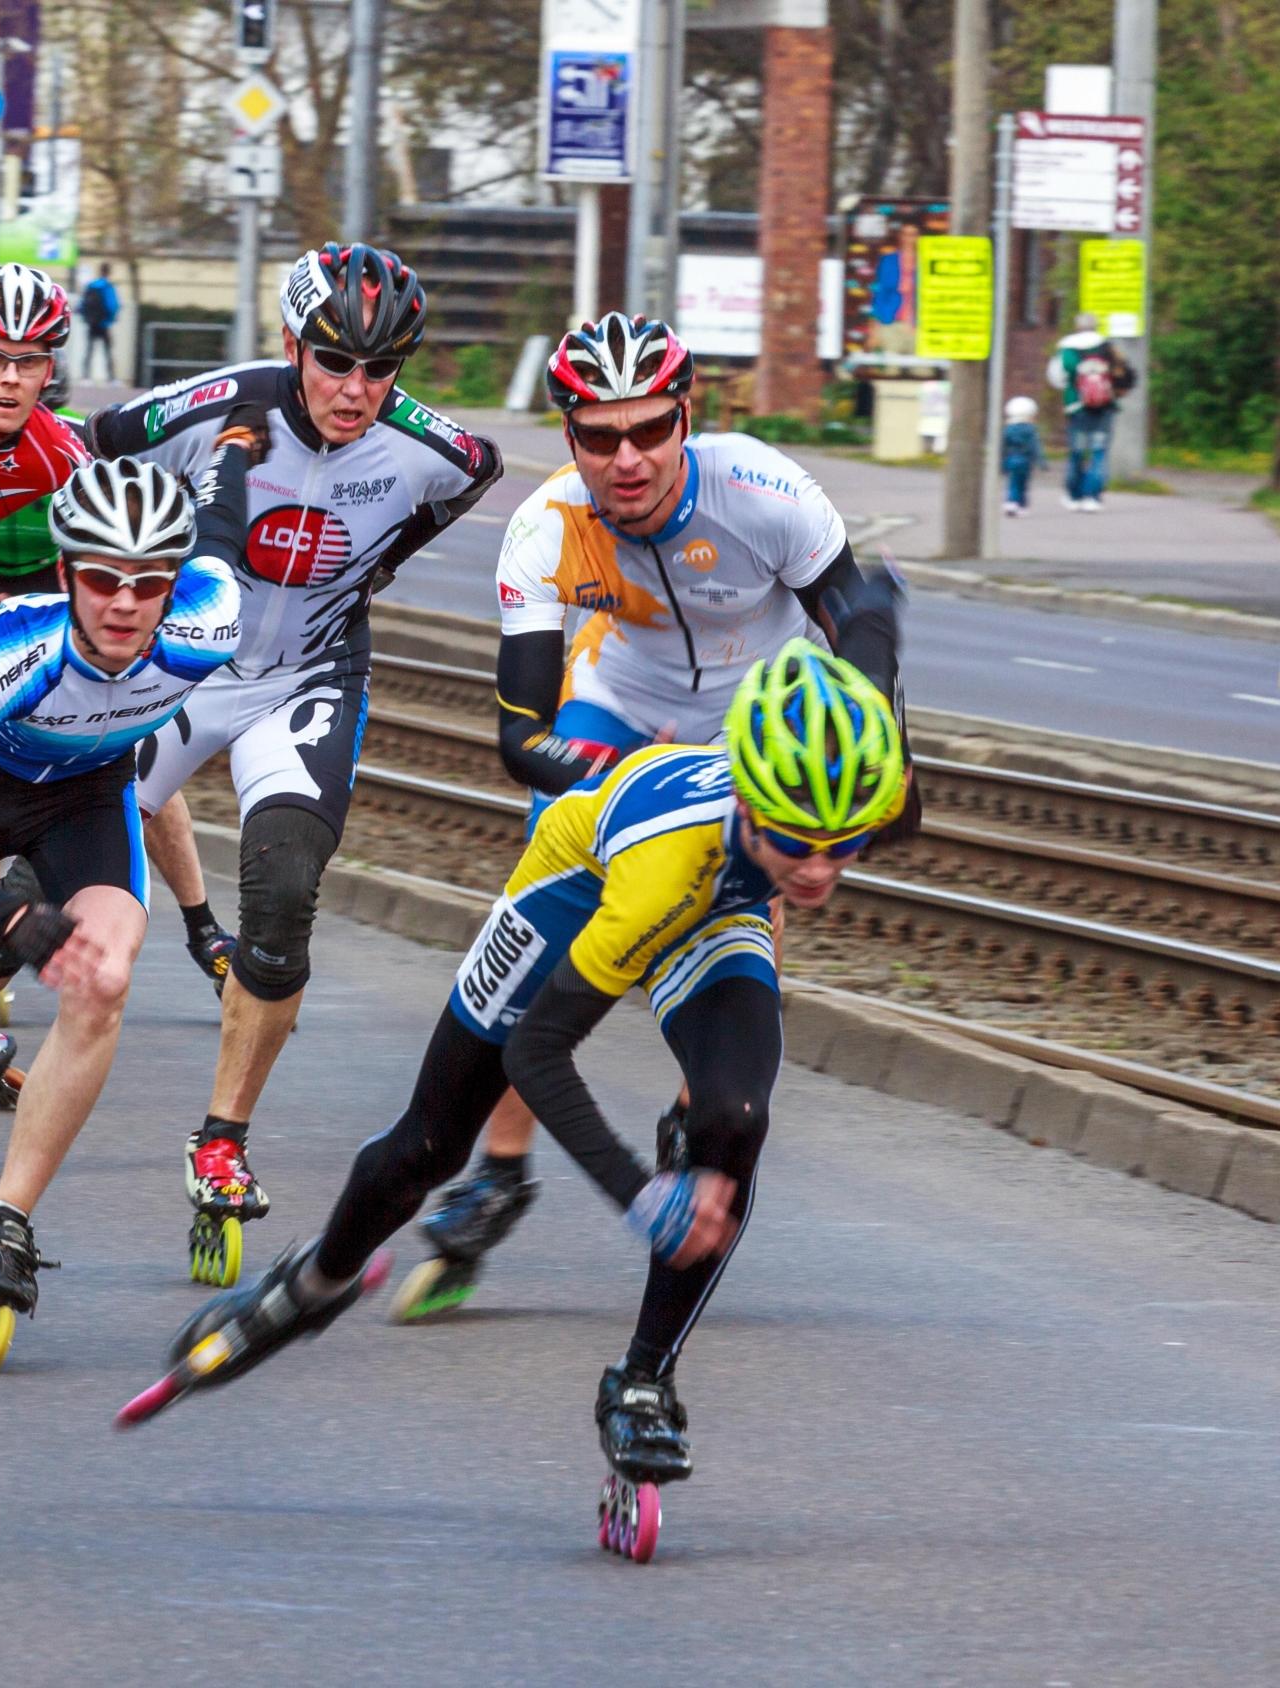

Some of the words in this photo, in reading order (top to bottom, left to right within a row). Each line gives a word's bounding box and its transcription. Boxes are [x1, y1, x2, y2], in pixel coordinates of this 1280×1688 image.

[258, 524, 313, 552] LOC
[162, 623, 205, 640] SSC
[26, 714, 79, 727] SSC
[463, 909, 534, 1013] 30026
